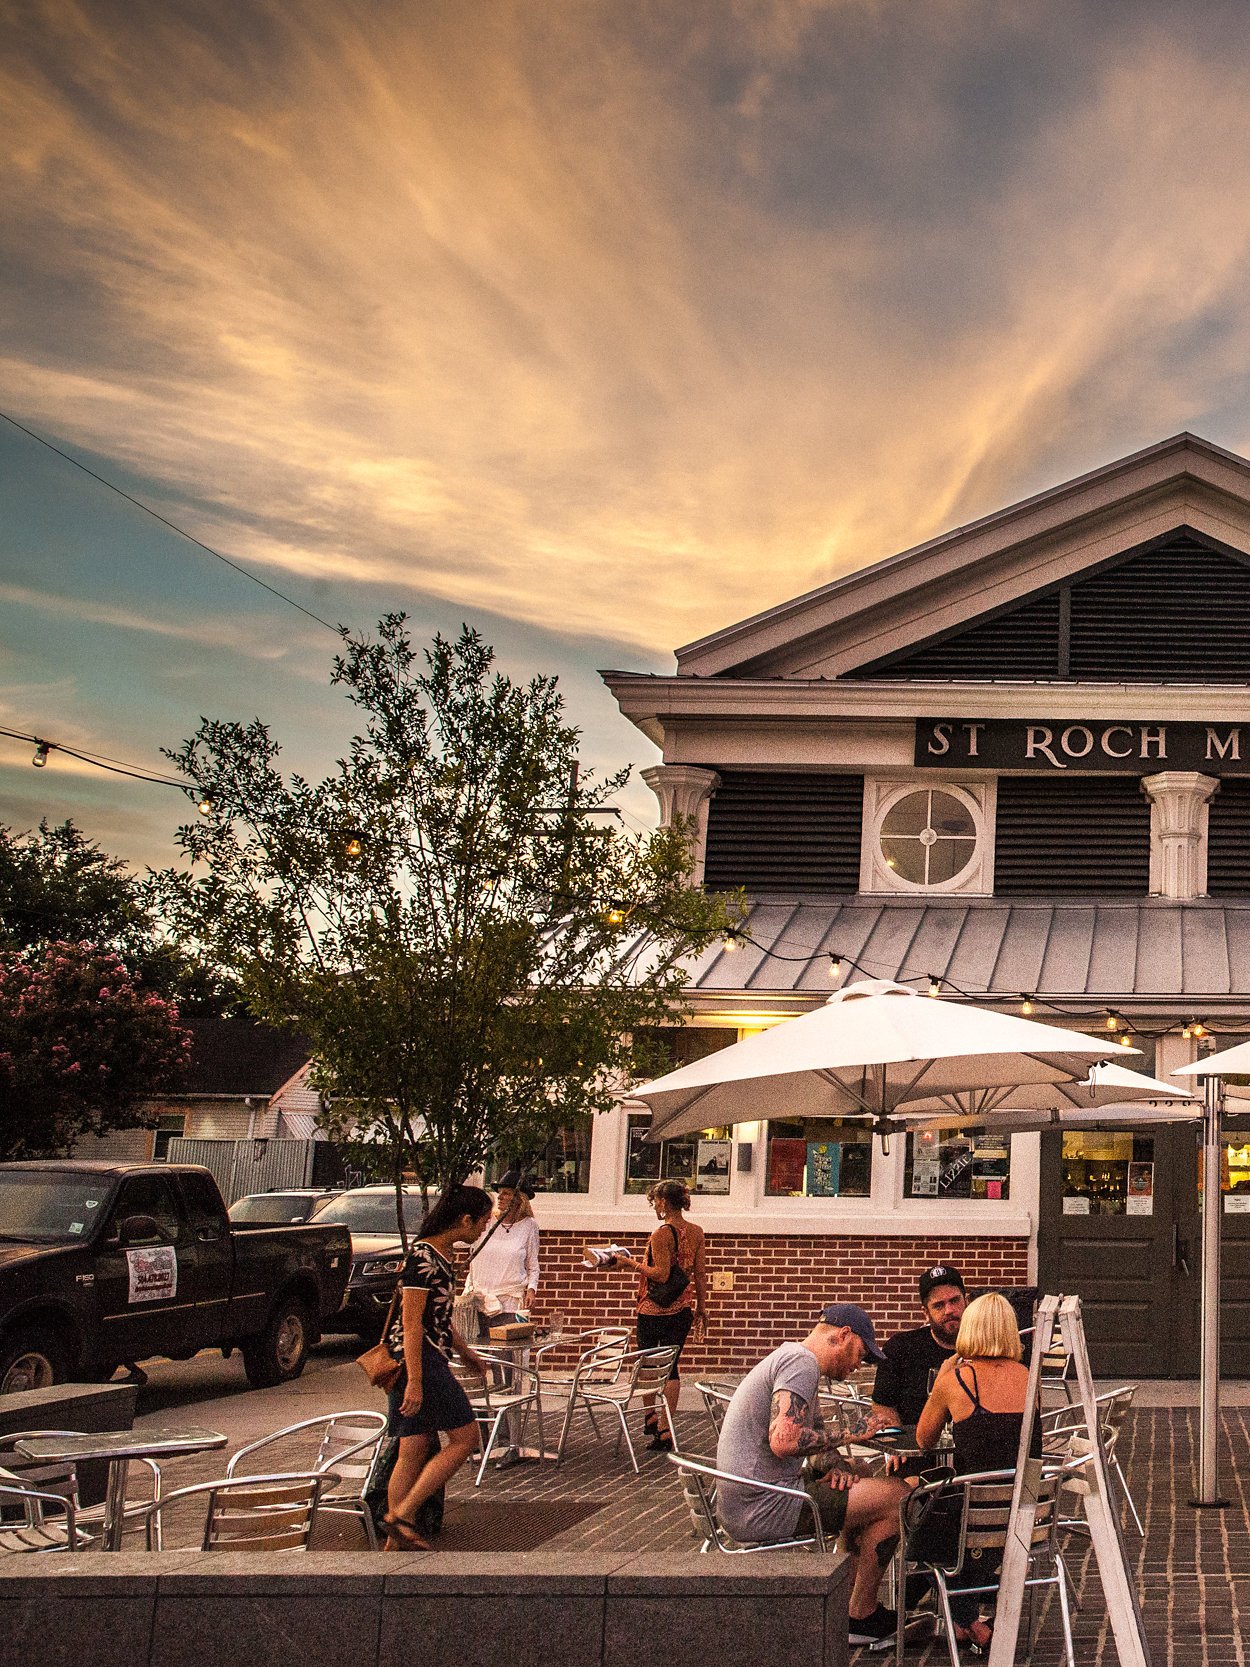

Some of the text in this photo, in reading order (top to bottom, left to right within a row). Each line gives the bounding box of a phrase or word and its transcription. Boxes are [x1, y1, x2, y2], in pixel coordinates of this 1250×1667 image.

[928, 723, 985, 756] ST
[1024, 725, 1168, 768] ROCH
[939, 1153, 972, 1189] LIZZIE
